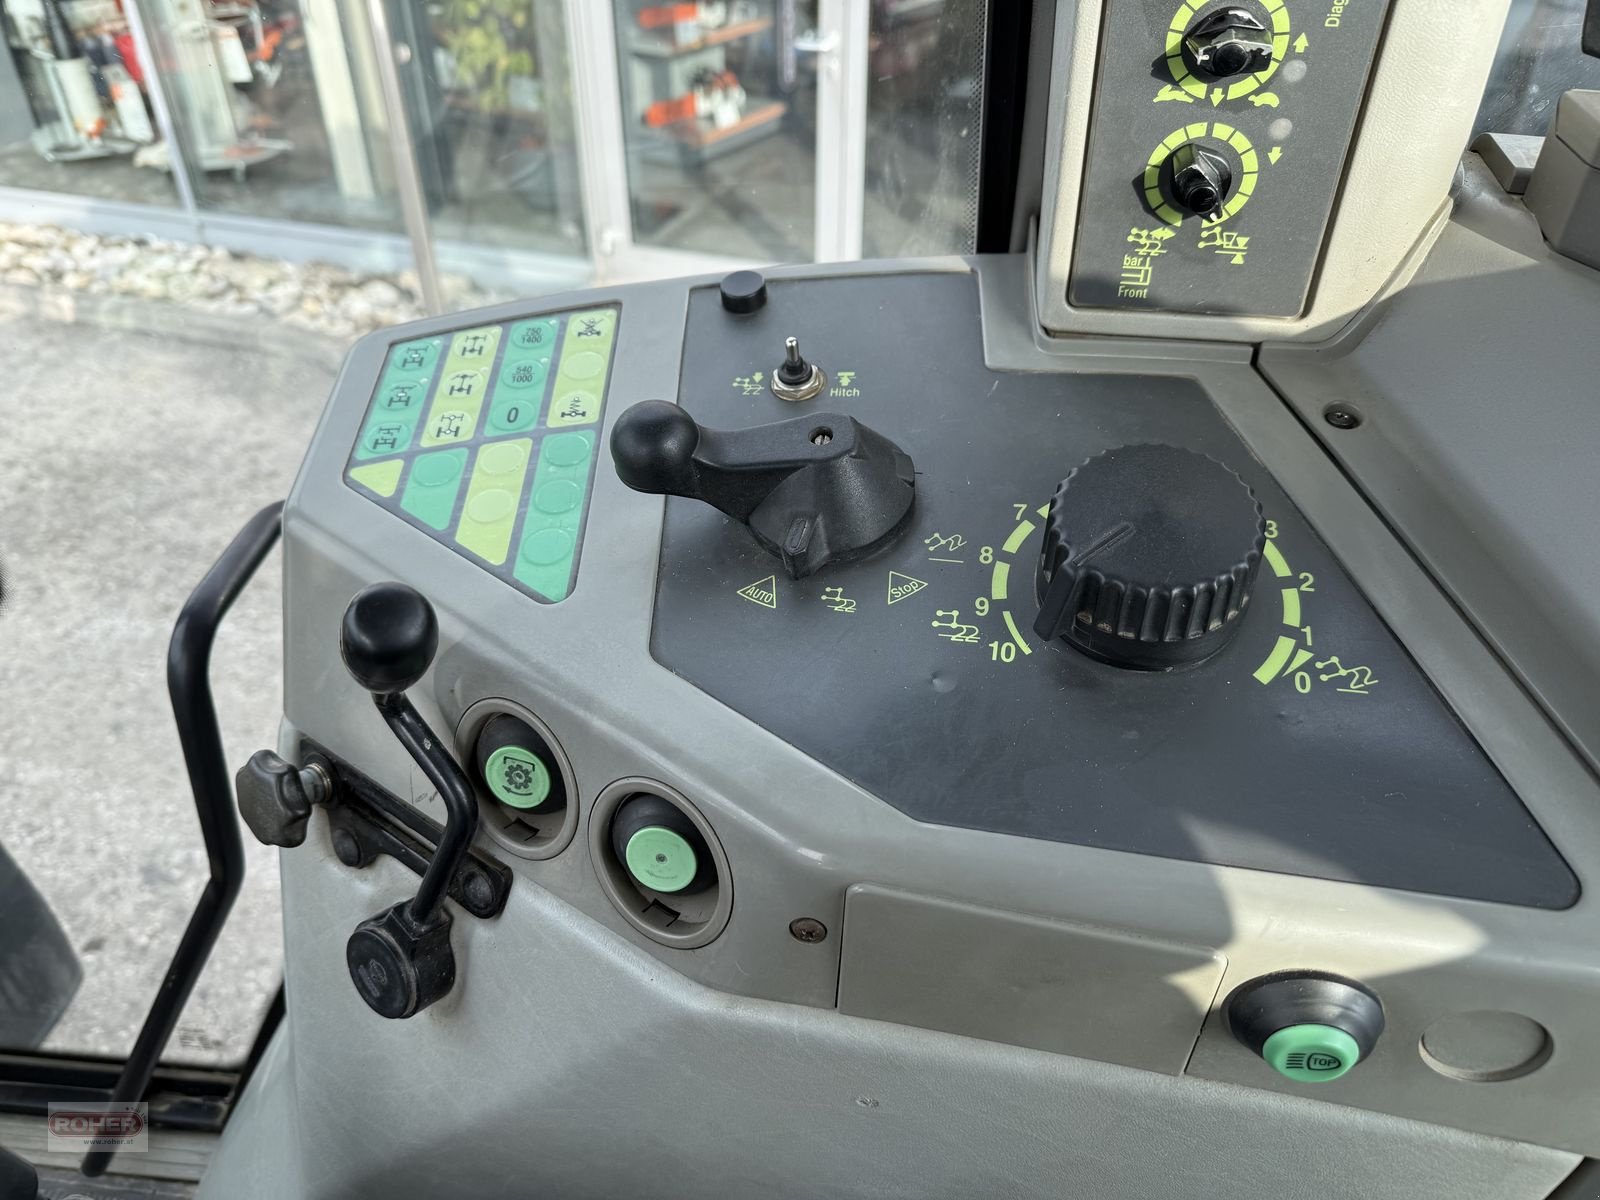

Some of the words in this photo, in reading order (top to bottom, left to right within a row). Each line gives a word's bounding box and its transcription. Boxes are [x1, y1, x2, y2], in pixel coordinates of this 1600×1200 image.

[1123, 253, 1144, 266] bar
[1117, 285, 1148, 299] Front
[521, 335, 542, 344] 1400
[526, 327, 542, 336] 750
[515, 365, 533, 374] 540
[512, 374, 533, 383] 1000
[829, 387, 860, 398] Hitch
[507, 407, 519, 423] 0
[1013, 504, 1028, 521] 7
[1264, 520, 1279, 538] 3
[979, 546, 993, 564] 8
[891, 580, 919, 599] Stop
[1298, 572, 1315, 592] 2
[746, 587, 772, 604] AUTO
[974, 597, 989, 616] 9
[1300, 625, 1312, 646] 1
[988, 640, 1016, 663] 10
[1294, 671, 1311, 694] 0
[1312, 1057, 1336, 1067] TOP
